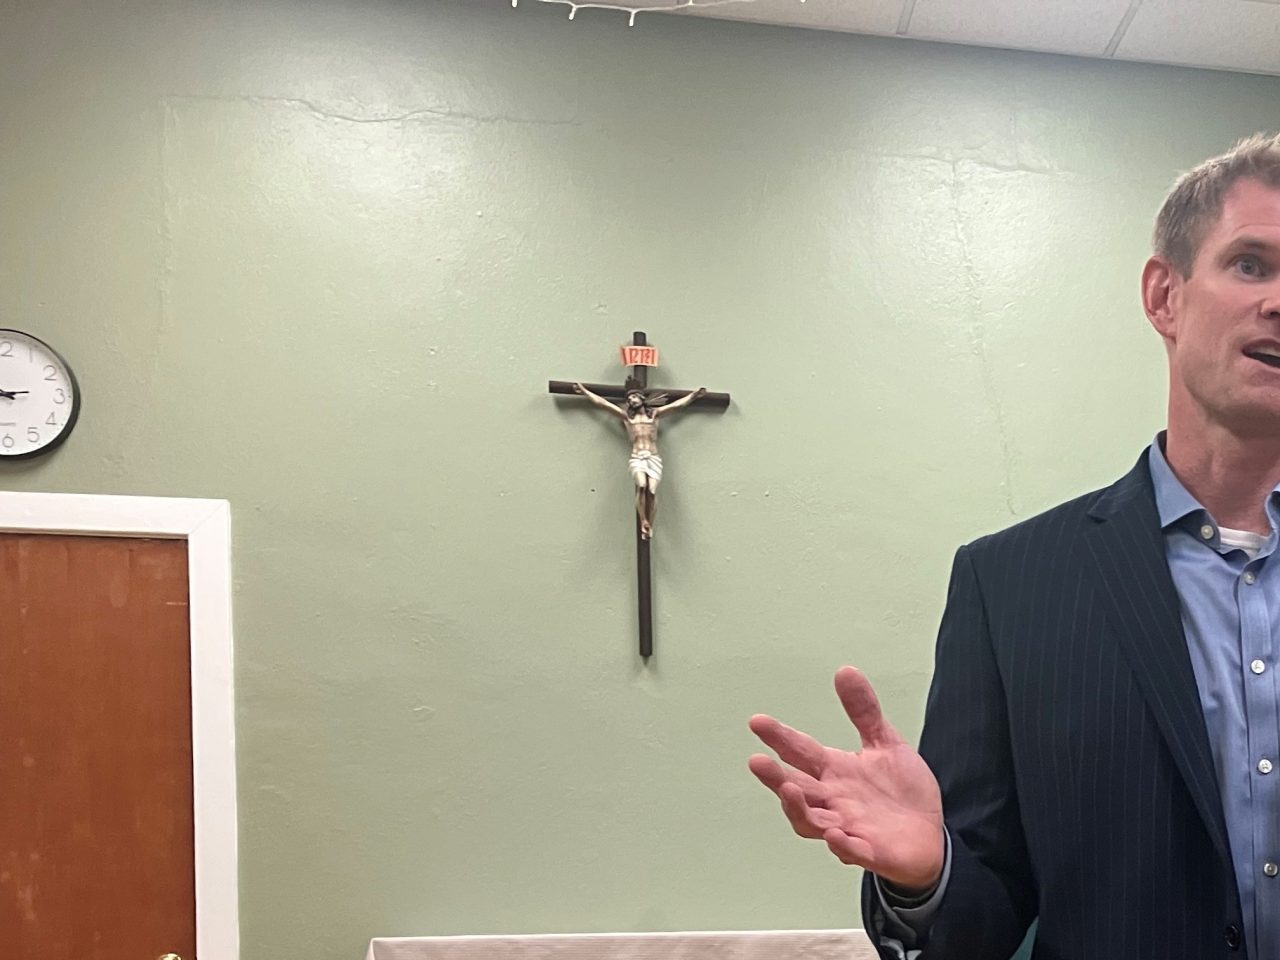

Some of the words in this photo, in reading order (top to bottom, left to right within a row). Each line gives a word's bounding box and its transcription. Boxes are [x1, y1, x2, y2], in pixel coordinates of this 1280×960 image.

[0, 341, 13, 357] 2
[43, 365, 57, 381] 2
[53, 389, 66, 405] 3
[45, 412, 57, 425] 4
[2, 434, 15, 448] 6
[27, 427, 40, 443] 5
